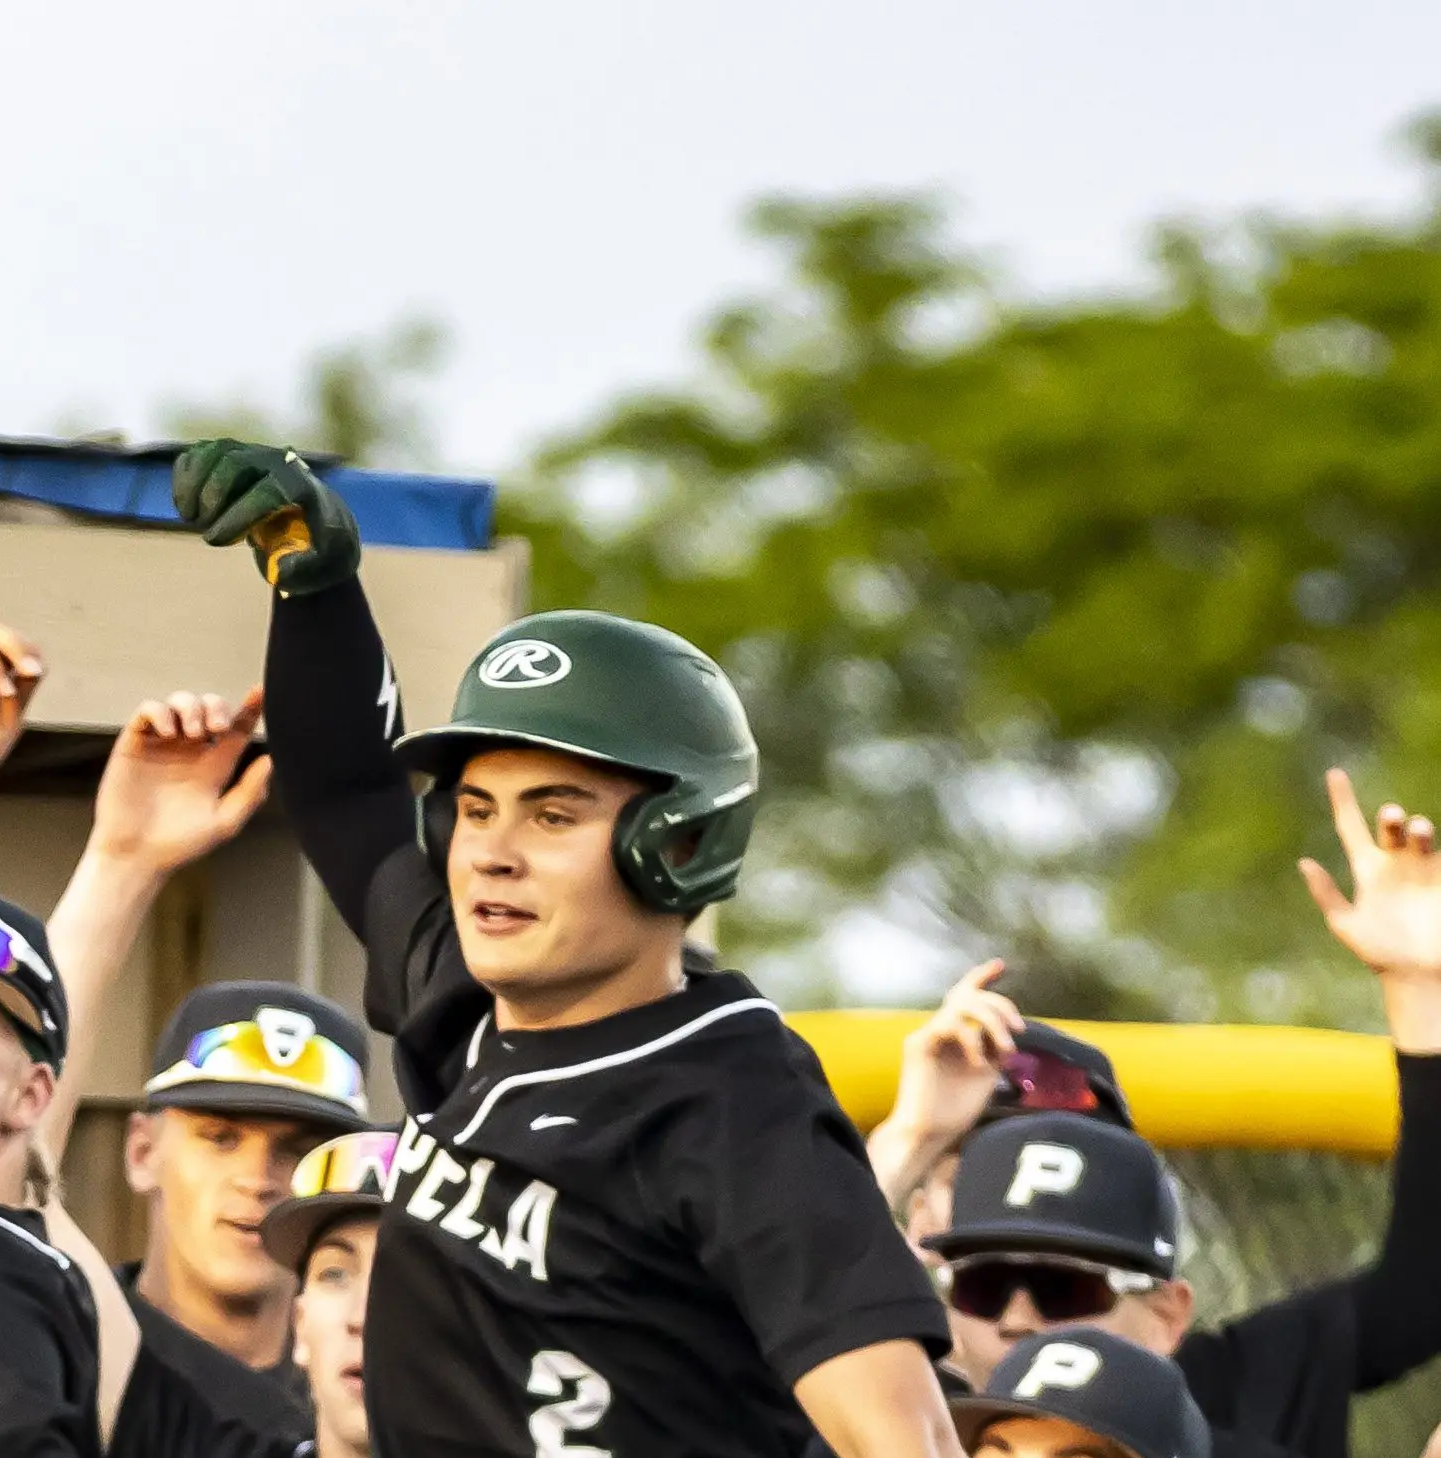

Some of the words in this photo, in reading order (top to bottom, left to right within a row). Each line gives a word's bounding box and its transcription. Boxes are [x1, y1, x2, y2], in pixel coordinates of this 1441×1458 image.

[384, 1113, 559, 1281] PELA
[1004, 1142, 1085, 1207] P
[1012, 1341, 1101, 1399] P
